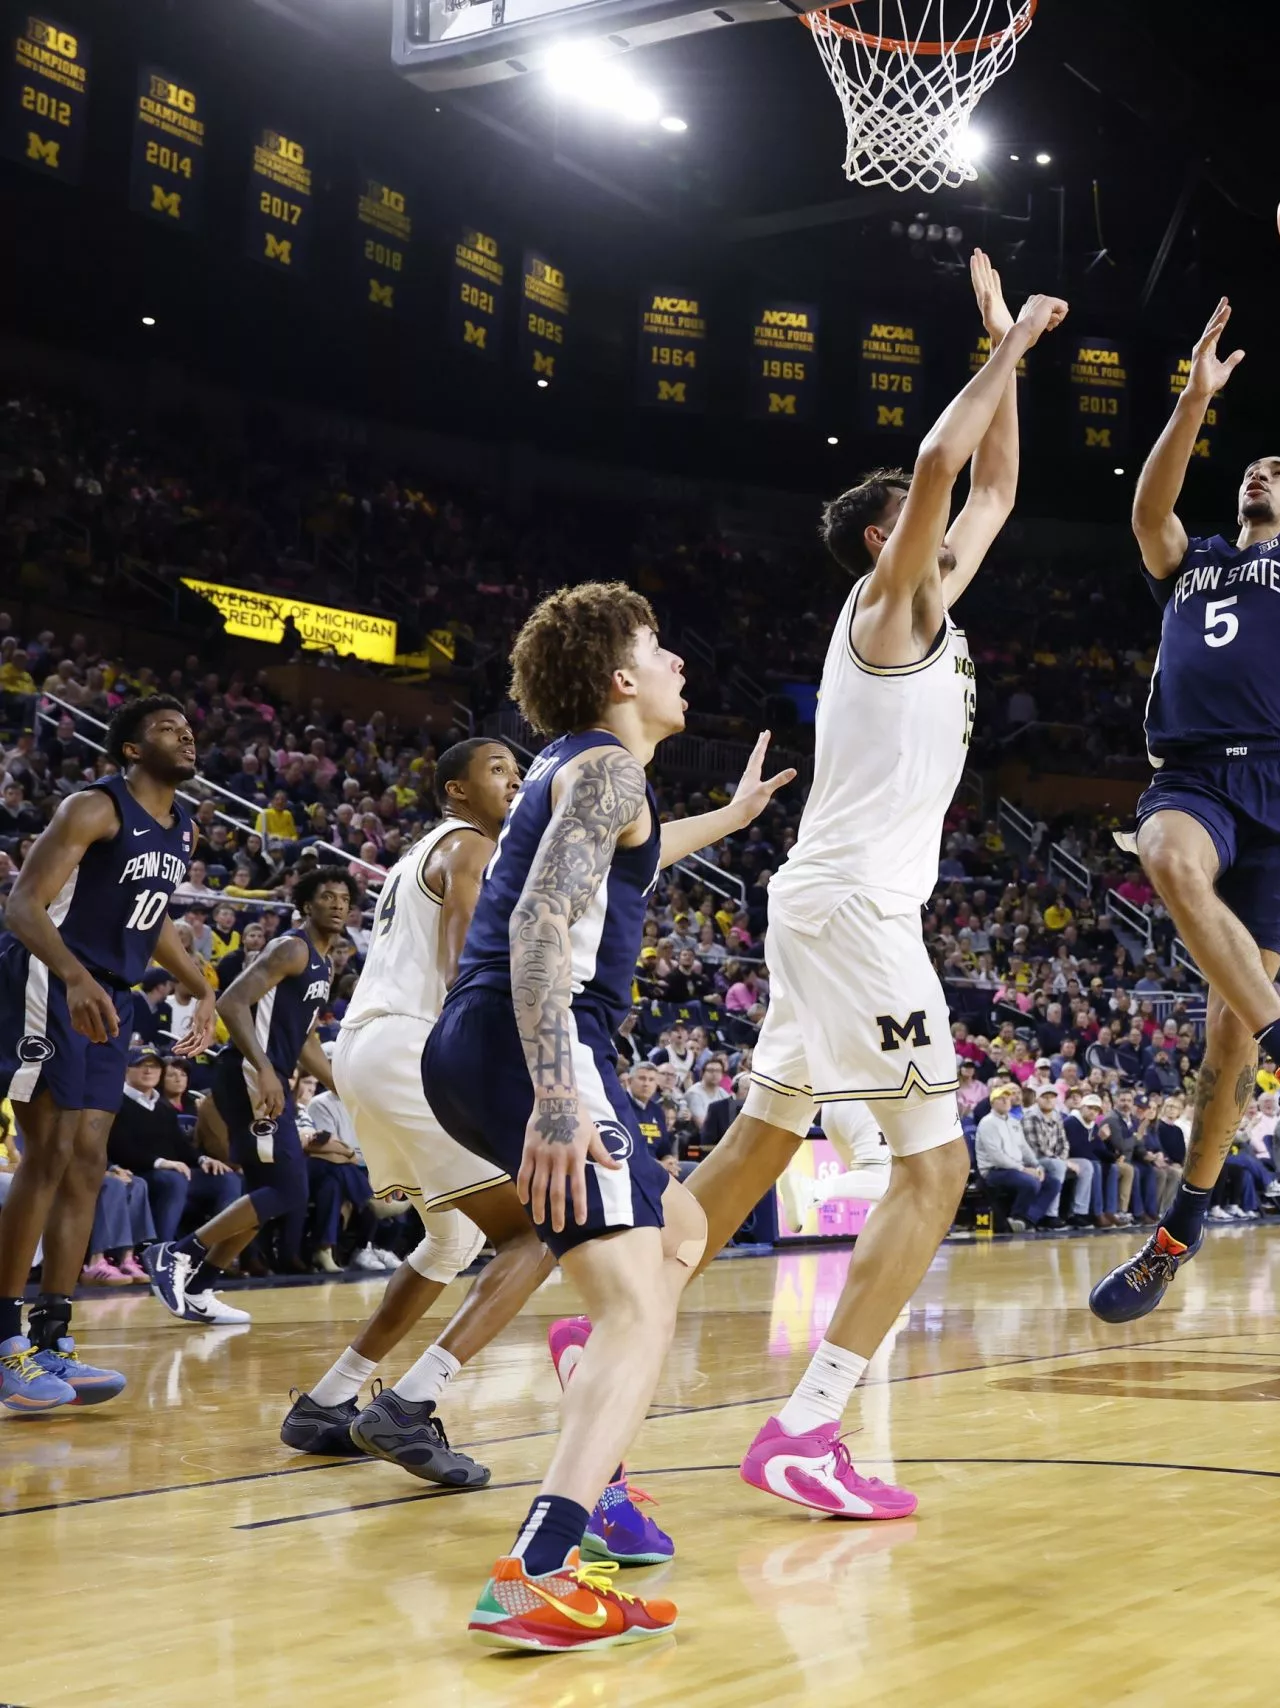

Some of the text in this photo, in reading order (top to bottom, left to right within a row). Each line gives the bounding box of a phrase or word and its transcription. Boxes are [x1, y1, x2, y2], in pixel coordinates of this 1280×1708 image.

[16, 37, 87, 82] CHAMPIONS
[22, 85, 72, 127] 2012
[139, 95, 205, 136] CHAMPIONS
[26, 131, 60, 168] M
[146, 140, 193, 179] 2014
[150, 184, 182, 220] M
[260, 191, 302, 225] 2017
[264, 232, 292, 265] M
[364, 239, 403, 272] 2018
[368, 278, 394, 309] M
[460, 283, 495, 315] 2021
[652, 296, 699, 315] NCAA
[644, 312, 706, 331] FINAL FOUR
[762, 310, 809, 328] NCAA
[870, 323, 915, 341] NCAA
[464, 319, 487, 350] M
[754, 326, 815, 344] FINAL FOUR
[862, 339, 921, 356] FINAL FOUR
[533, 350, 555, 377] M
[651, 346, 696, 369] 1964
[762, 359, 805, 381] 1965
[1071, 363, 1099, 377] FINAL
[1078, 348, 1120, 365] NCAA
[657, 380, 686, 403] M
[870, 372, 912, 394] 1976
[1170, 374, 1189, 385] FIN
[768, 392, 797, 415] M
[876, 405, 905, 428] M
[1079, 396, 1118, 415] 2013
[1085, 427, 1112, 448] M
[1174, 558, 1280, 614] PENN STATE
[289, 605, 309, 620] OF
[316, 612, 392, 637] MICHIGAN
[303, 624, 354, 645] UNION
[1203, 595, 1239, 648] 5
[1225, 746, 1248, 756] PSU
[118, 851, 161, 884] PENN
[125, 889, 169, 931] 10
[380, 873, 402, 936] 4
[876, 1010, 931, 1051] M
